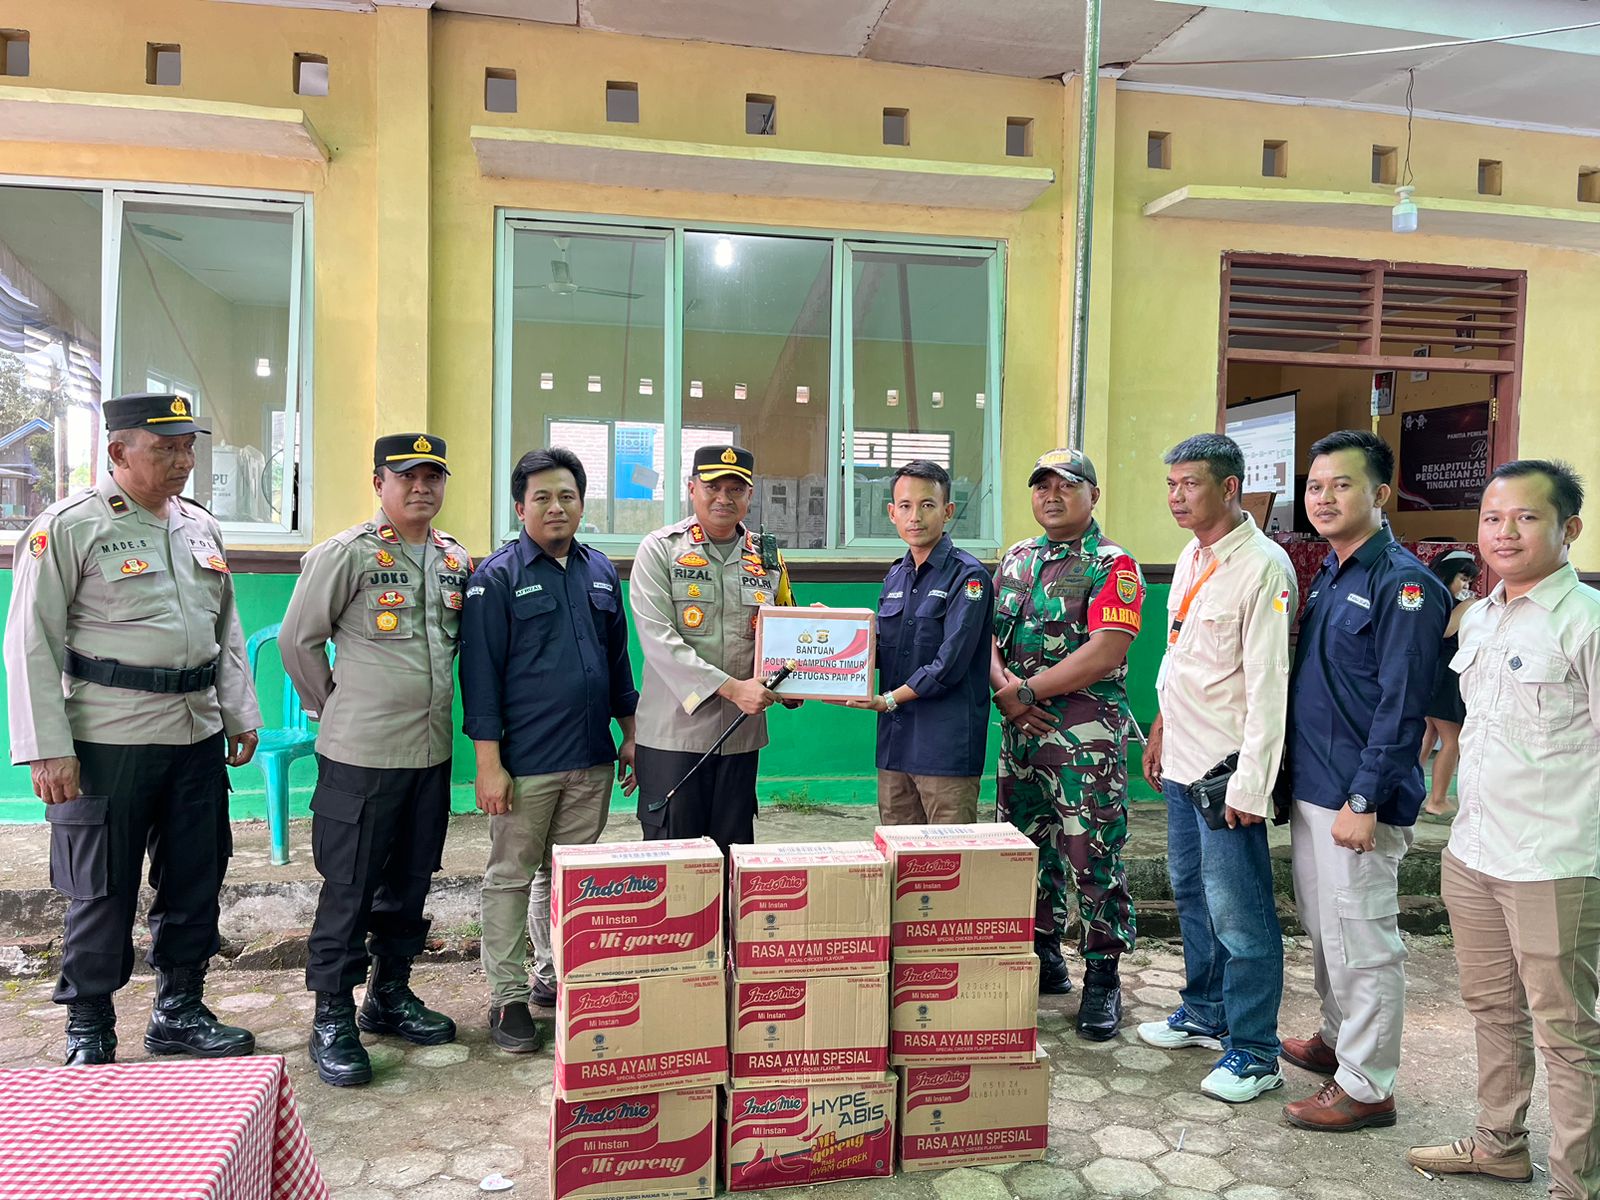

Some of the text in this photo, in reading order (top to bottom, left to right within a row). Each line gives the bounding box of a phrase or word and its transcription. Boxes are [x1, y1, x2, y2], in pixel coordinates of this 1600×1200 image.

[1416, 470, 1470, 481] PEROLEHAN
[1426, 480, 1458, 489] TINGKAT
[190, 538, 217, 550] POL
[370, 572, 408, 584] JOKO
[674, 568, 712, 580] RIZAL
[742, 576, 772, 589] POLRI
[796, 646, 835, 655] BANTUAN
[765, 657, 865, 669] POLR LAMPUNG TIMUR
[793, 671, 830, 680] PETUGAS
[832, 673, 848, 681] PAM
[850, 674, 866, 682] PPK
[592, 915, 637, 925] Mi Instan
[906, 921, 1023, 937] RASA AYAM SPESIAL
[590, 932, 694, 951] Mi goreng
[752, 940, 875, 958] RASA AYAM SPESIAL
[904, 1032, 1024, 1047] RASA AYAM SPESIAL
[581, 1051, 712, 1079] RASA AYAM SPESIAL
[749, 1050, 872, 1069] RASA AYAM SPESIAL
[812, 1092, 870, 1117] HYPE
[838, 1104, 884, 1128] ABIS
[752, 1127, 787, 1135] Mi Instan
[584, 1140, 629, 1151] Mi Instan
[811, 1131, 836, 1151] Mi
[917, 1130, 1033, 1150] RASA AYAM SPESIAL
[812, 1133, 865, 1164] goreng
[582, 1156, 686, 1176] Mi goreng
[811, 1152, 868, 1176] AYAM GEPREK
